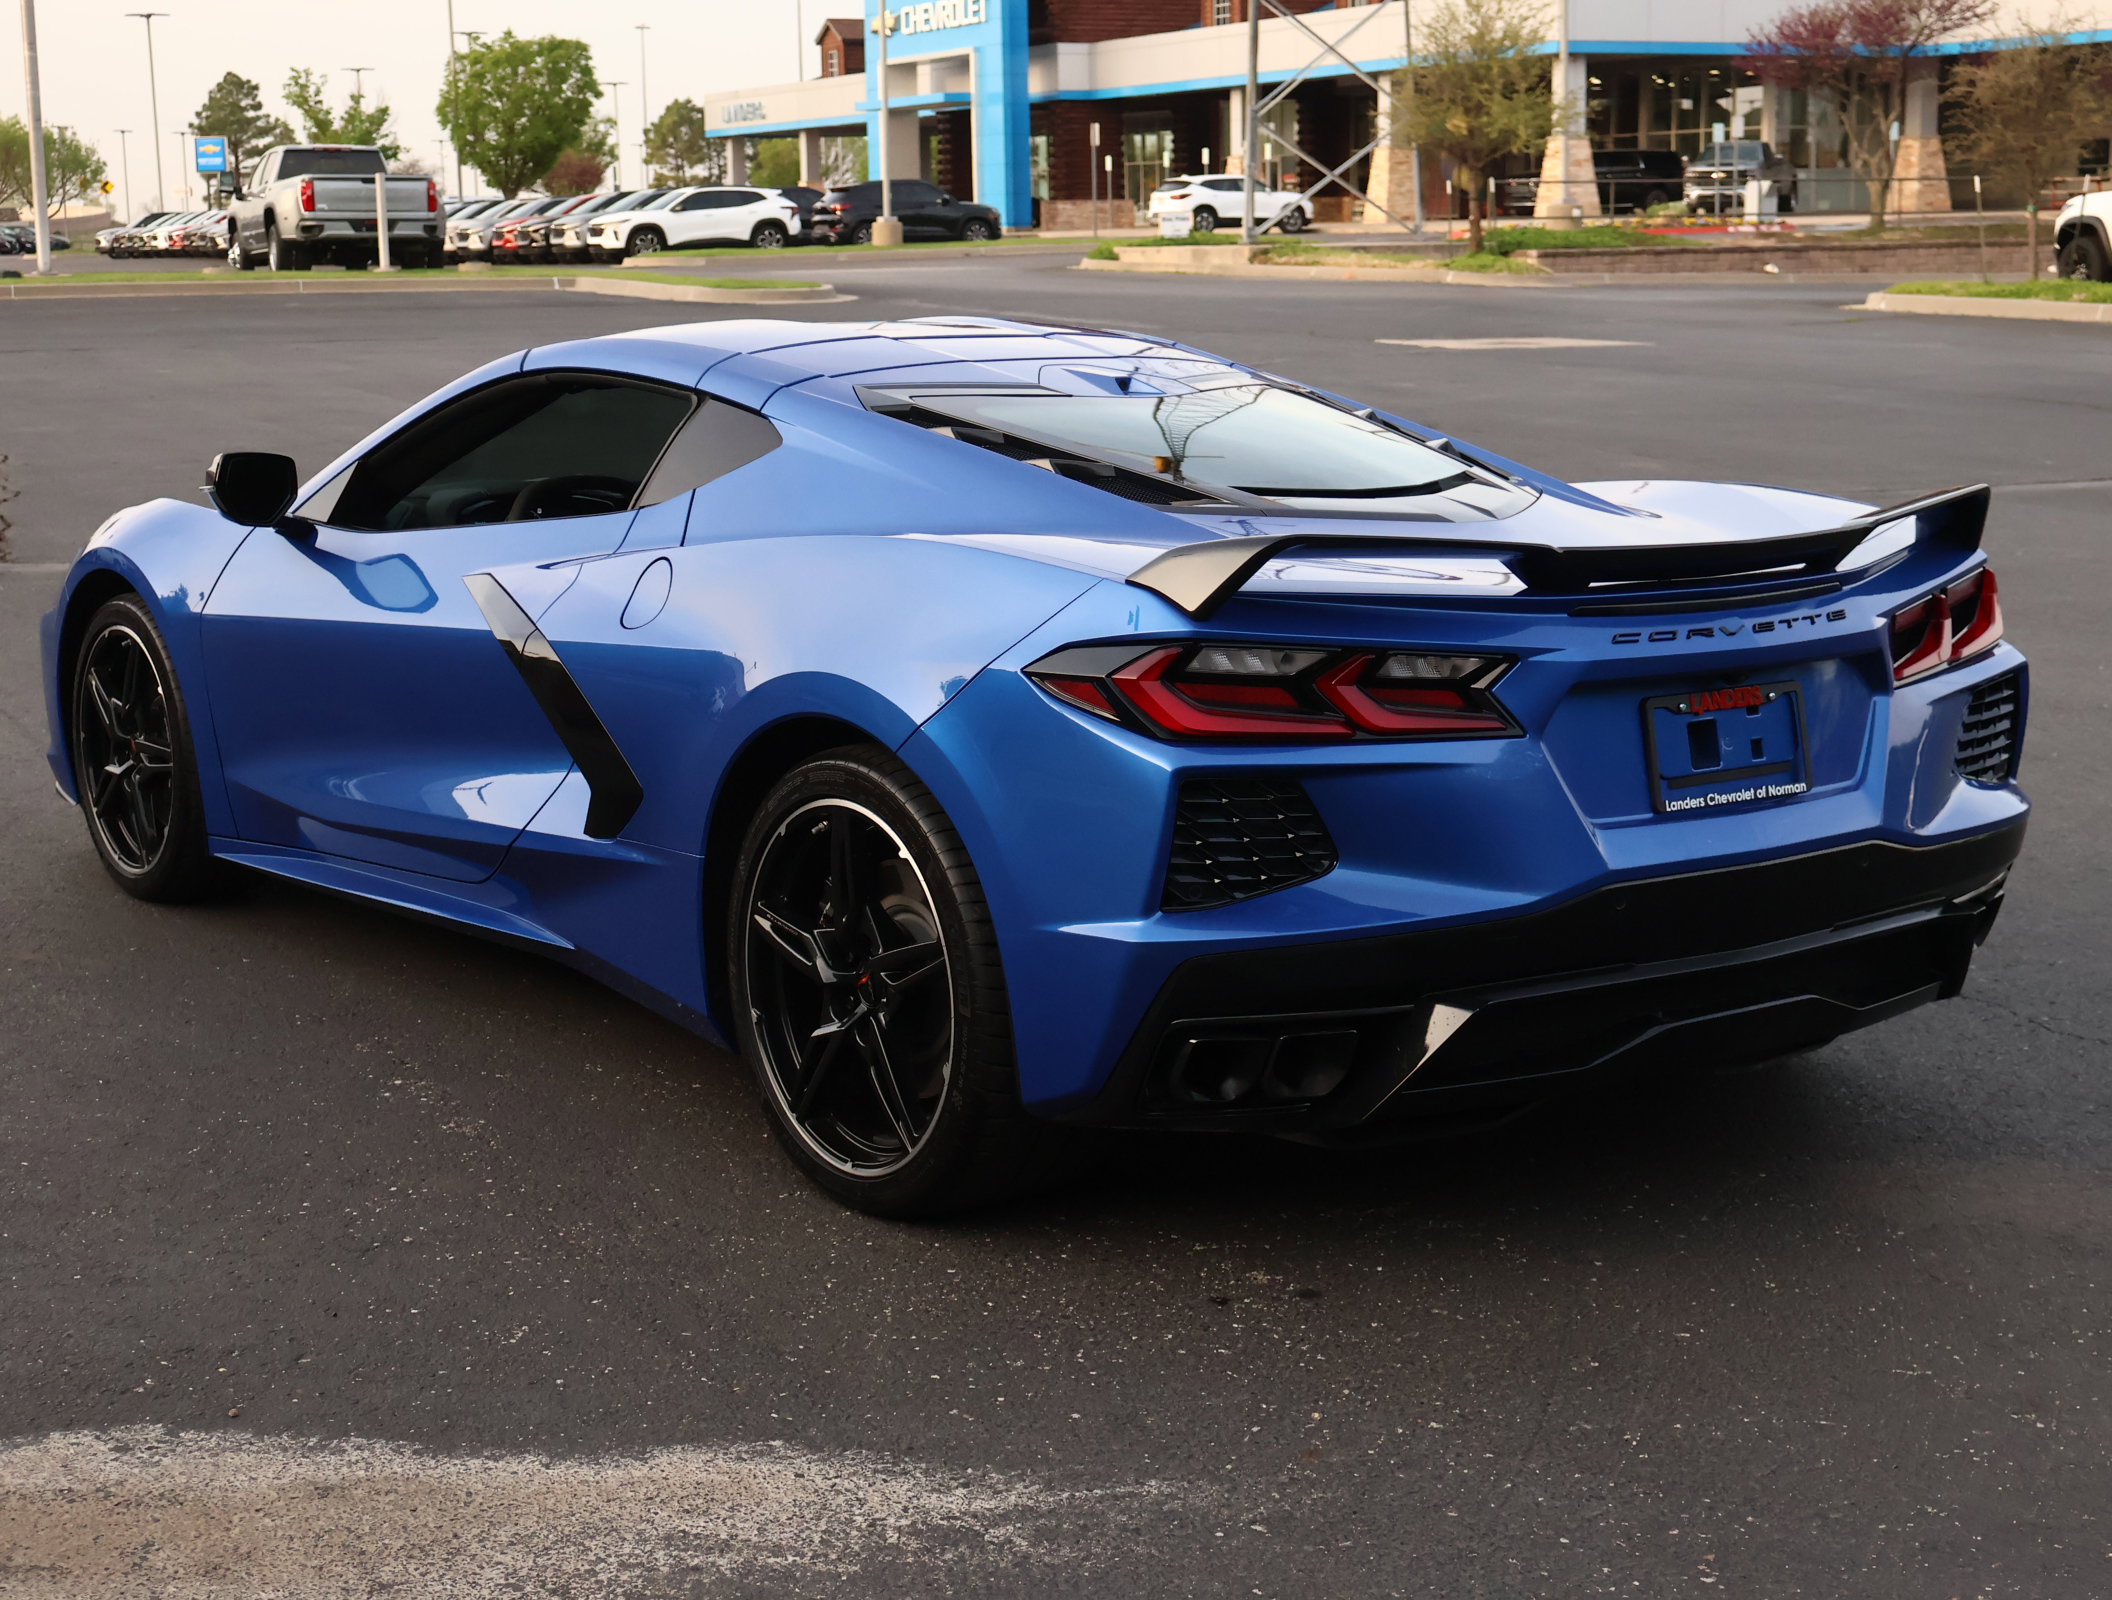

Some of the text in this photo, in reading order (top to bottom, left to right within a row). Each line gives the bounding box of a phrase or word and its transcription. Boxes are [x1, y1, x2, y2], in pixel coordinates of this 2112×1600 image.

[900, 0, 986, 35] CHEVROLET
[1611, 609, 1847, 644] CORVETTE
[1690, 685, 1762, 715] LANDERS
[1665, 782, 1808, 812] Landers Chevrolet of Norman
